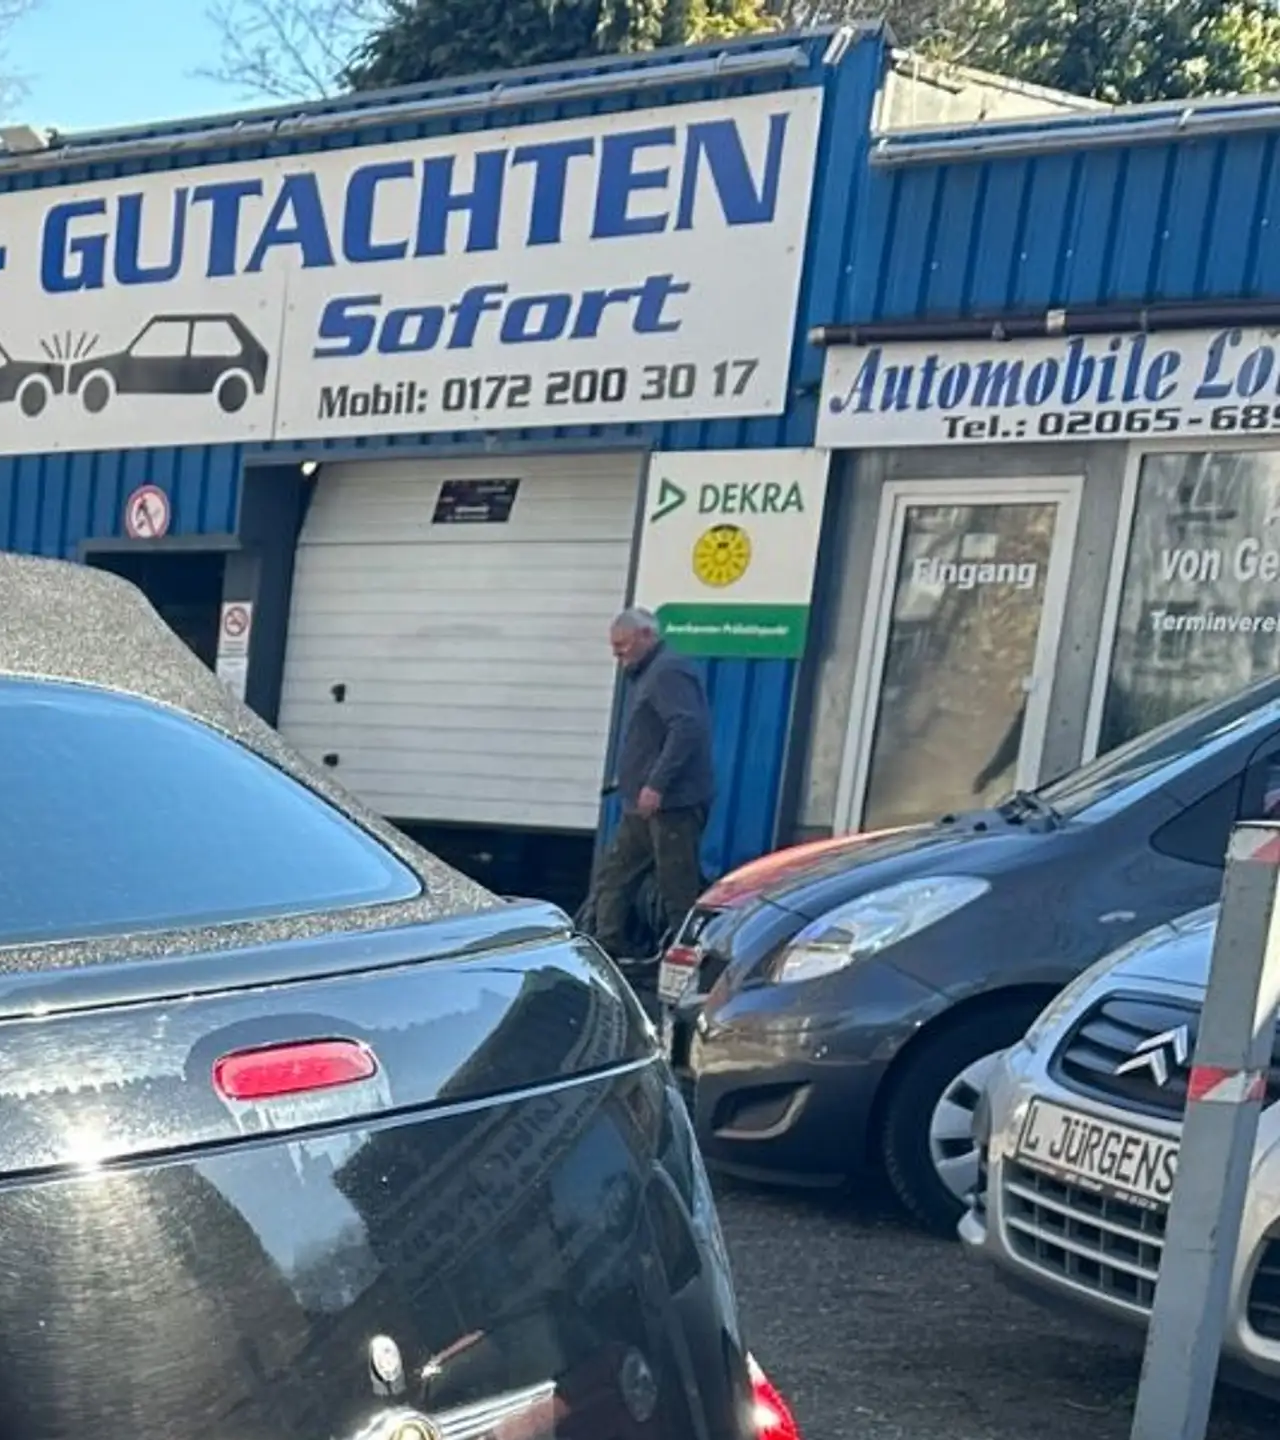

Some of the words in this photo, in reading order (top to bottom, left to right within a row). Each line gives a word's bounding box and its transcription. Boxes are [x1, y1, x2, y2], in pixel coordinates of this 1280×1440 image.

[40, 112, 790, 294] GUTACHTEN
[313, 274, 691, 359] Sofort
[317, 380, 428, 420] Mobil:
[442, 373, 532, 412] 0172
[545, 367, 628, 406] 200
[640, 362, 697, 400] 30
[713, 358, 760, 397] 17
[829, 334, 1182, 415] Automobile
[1195, 326, 1280, 400] Lo
[944, 413, 1026, 440] Tel.:
[698, 481, 805, 514] DEKRA
[913, 556, 1037, 590] Eingang
[1160, 547, 1222, 581] von
[1234, 537, 1280, 582] Ge
[1050, 1115, 1178, 1195] JÜRGENS
